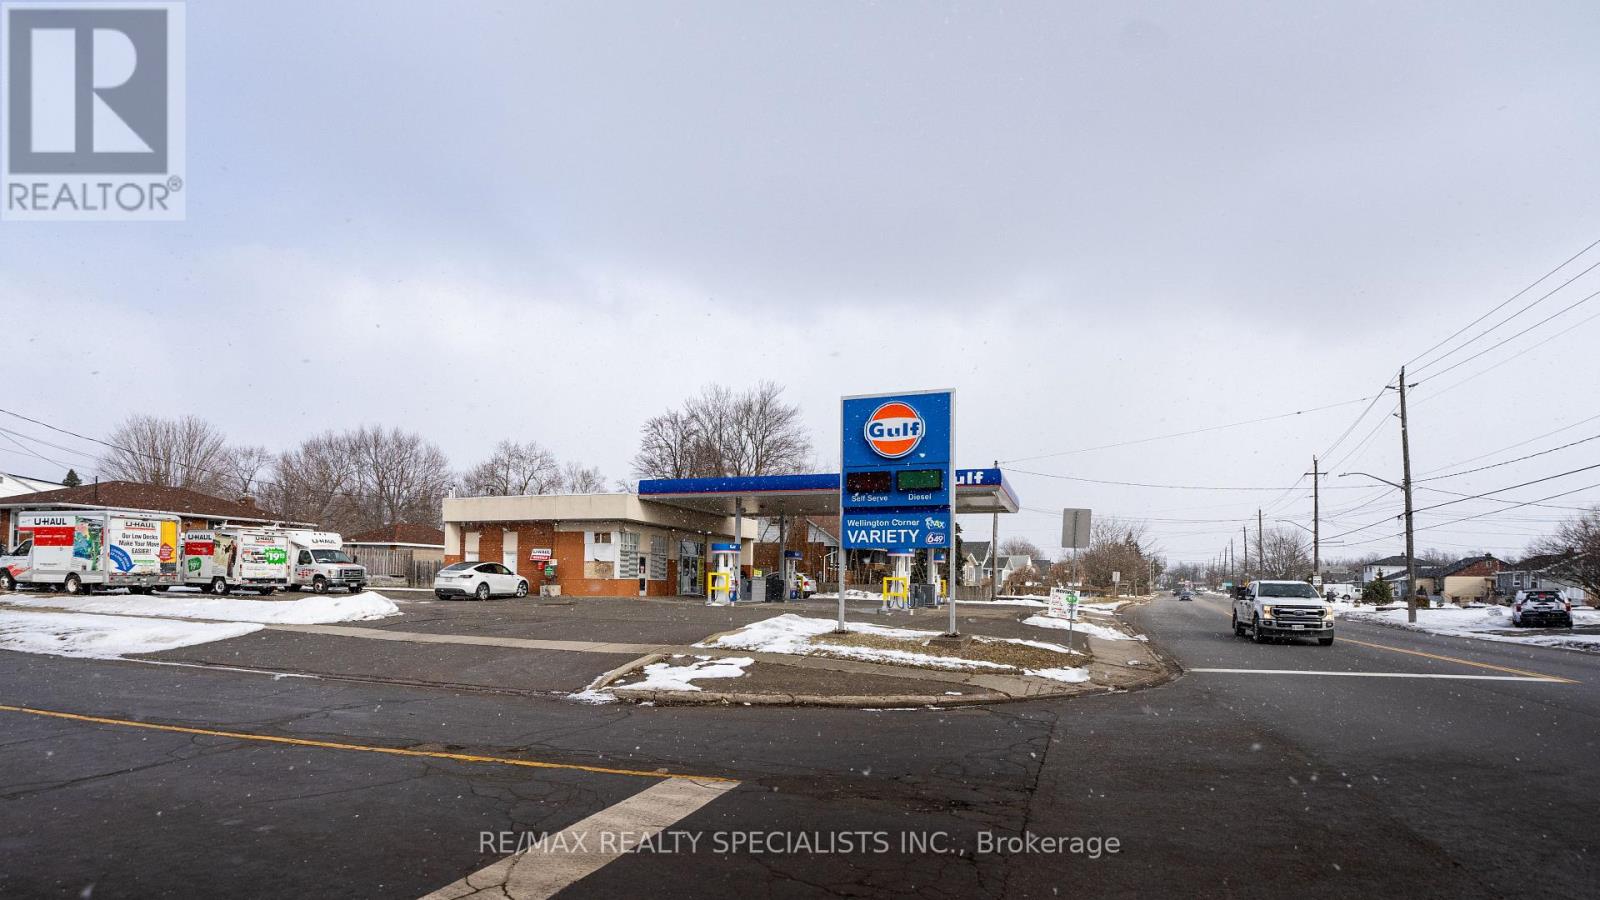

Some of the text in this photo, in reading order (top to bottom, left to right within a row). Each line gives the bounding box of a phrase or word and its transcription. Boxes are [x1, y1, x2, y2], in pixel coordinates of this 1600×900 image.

[868, 422, 920, 438] Gulf
[955, 471, 984, 485] ulf
[867, 494, 888, 502] Serve
[33, 517, 67, 526] U-HAUL
[847, 518, 920, 528] Wellington Corner
[847, 529, 919, 543] VARIETY
